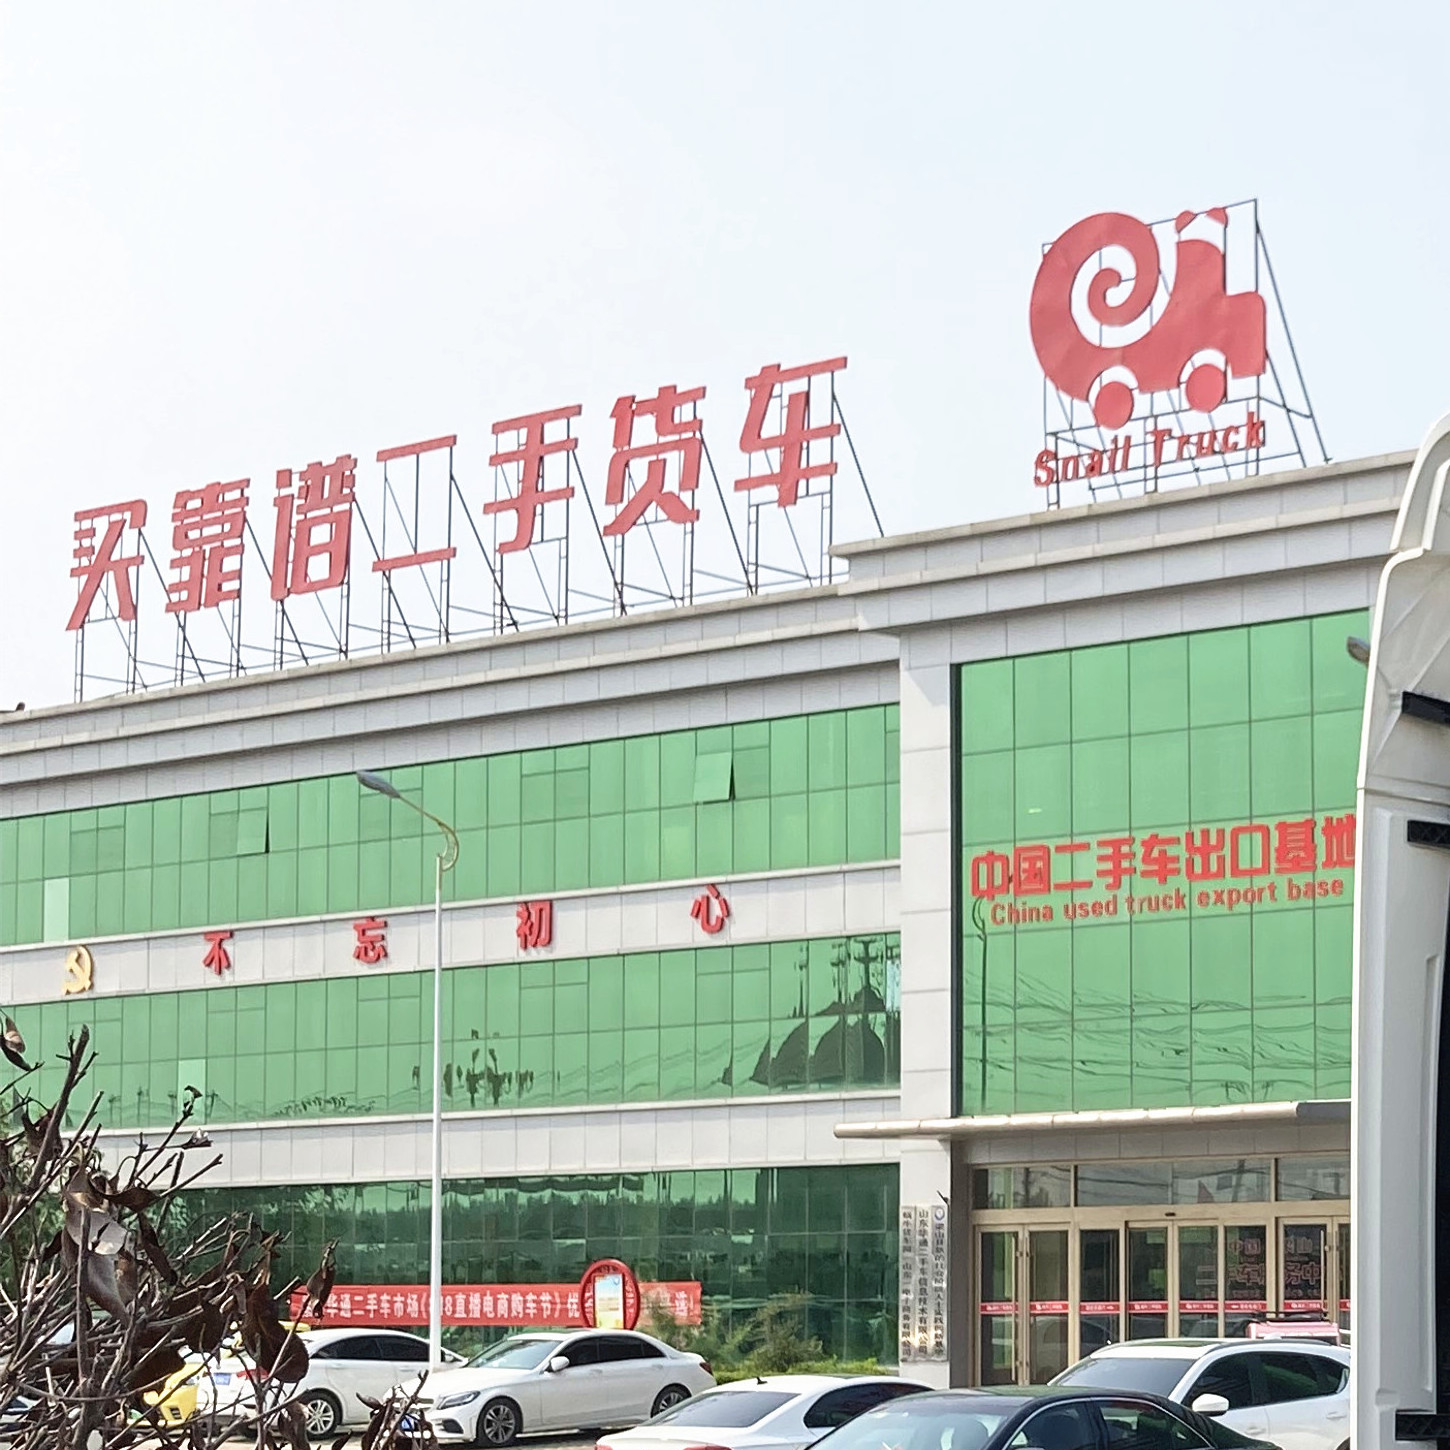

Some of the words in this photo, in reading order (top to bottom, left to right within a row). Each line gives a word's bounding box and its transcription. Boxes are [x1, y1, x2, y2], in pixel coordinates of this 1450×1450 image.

[1034, 434, 1132, 488] Snail
[1150, 411, 1265, 468] Truck
[66, 356, 848, 631] 买靠谱二手货车
[971, 813, 1357, 900] 中国二手车出口基地
[203, 883, 730, 976] 不忘初心
[990, 902, 1053, 926] China
[1063, 895, 1117, 920] used
[1125, 887, 1186, 915] truck
[1196, 877, 1277, 908] export
[1287, 877, 1343, 900] base
